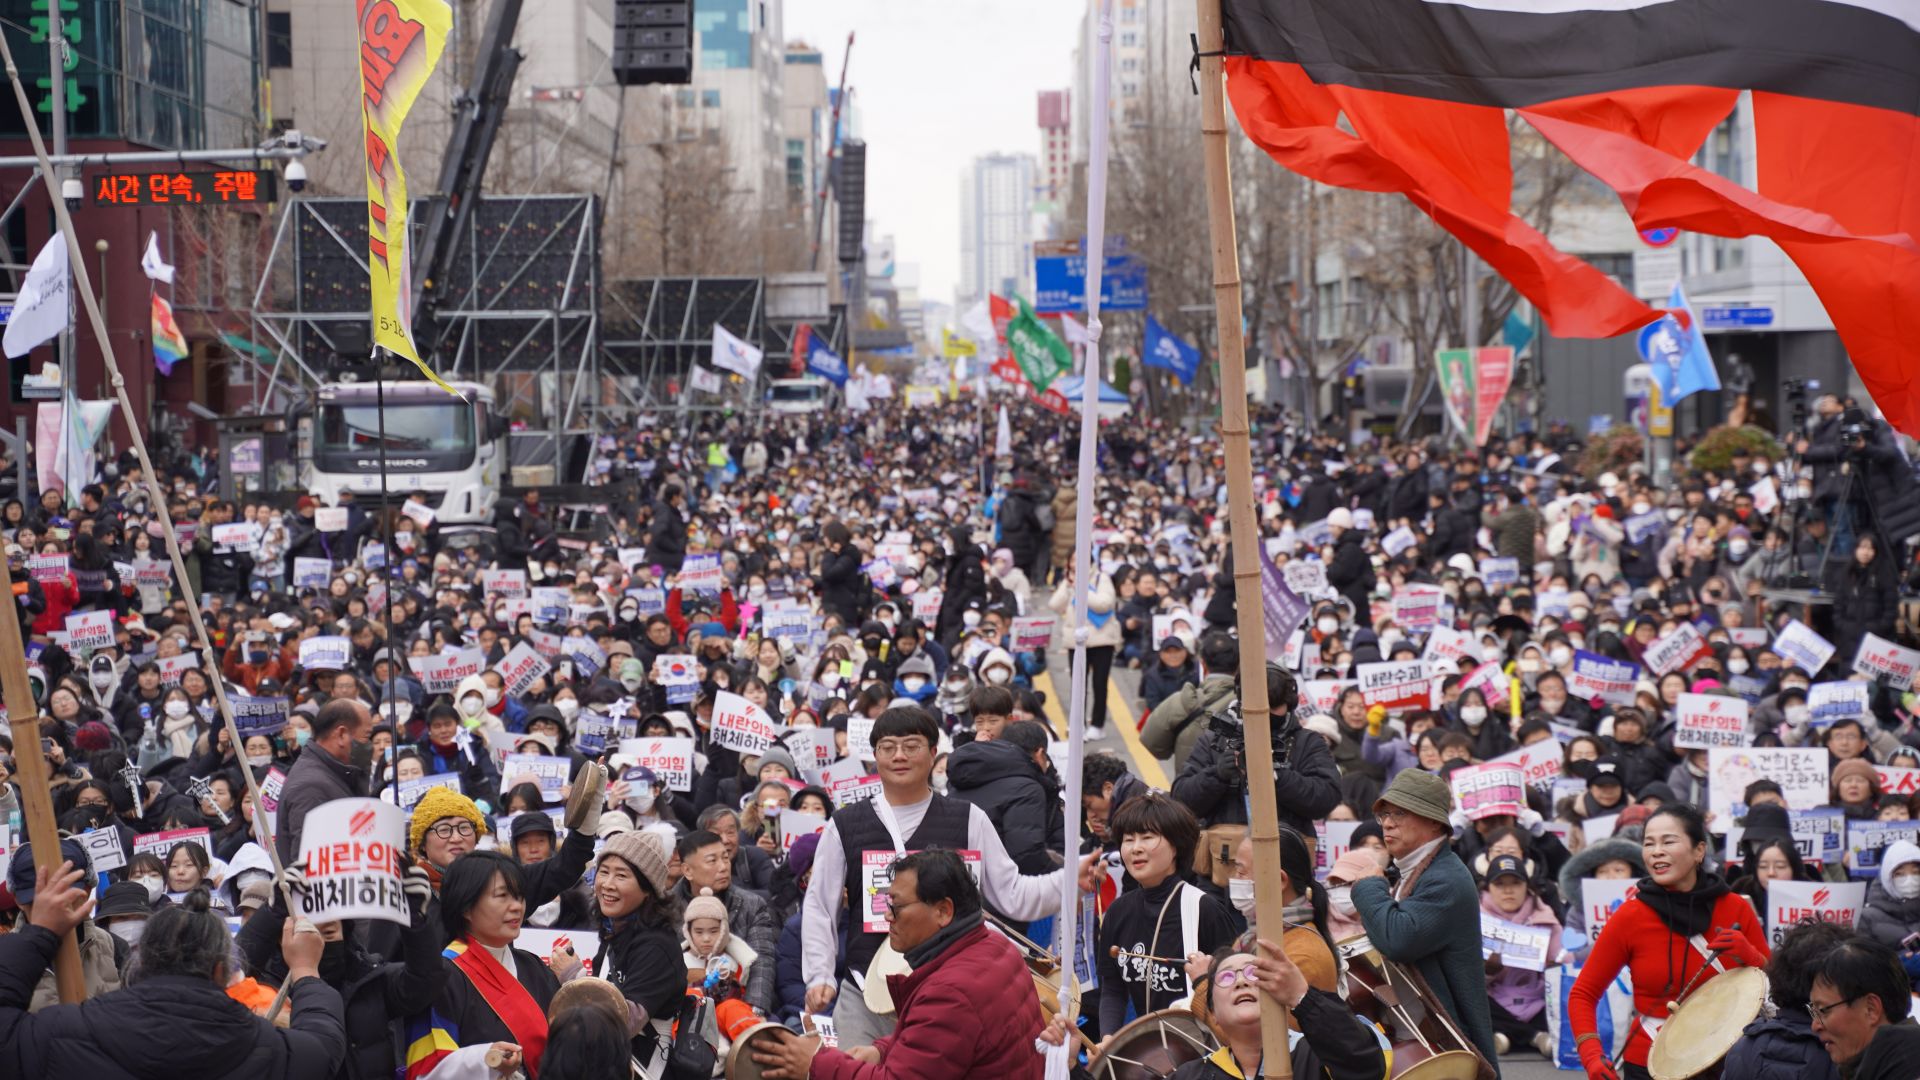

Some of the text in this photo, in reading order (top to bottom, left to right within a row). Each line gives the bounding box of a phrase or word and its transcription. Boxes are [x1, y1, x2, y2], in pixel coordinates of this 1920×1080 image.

[98, 171, 257, 203] 시간 단속, 주말
[1365, 664, 1423, 688] 내란수괴
[719, 711, 777, 741] 내란의힘
[1684, 713, 1742, 731] 내란의힘
[1679, 729, 1744, 747] 해체하라!
[637, 756, 685, 771] 란의힘
